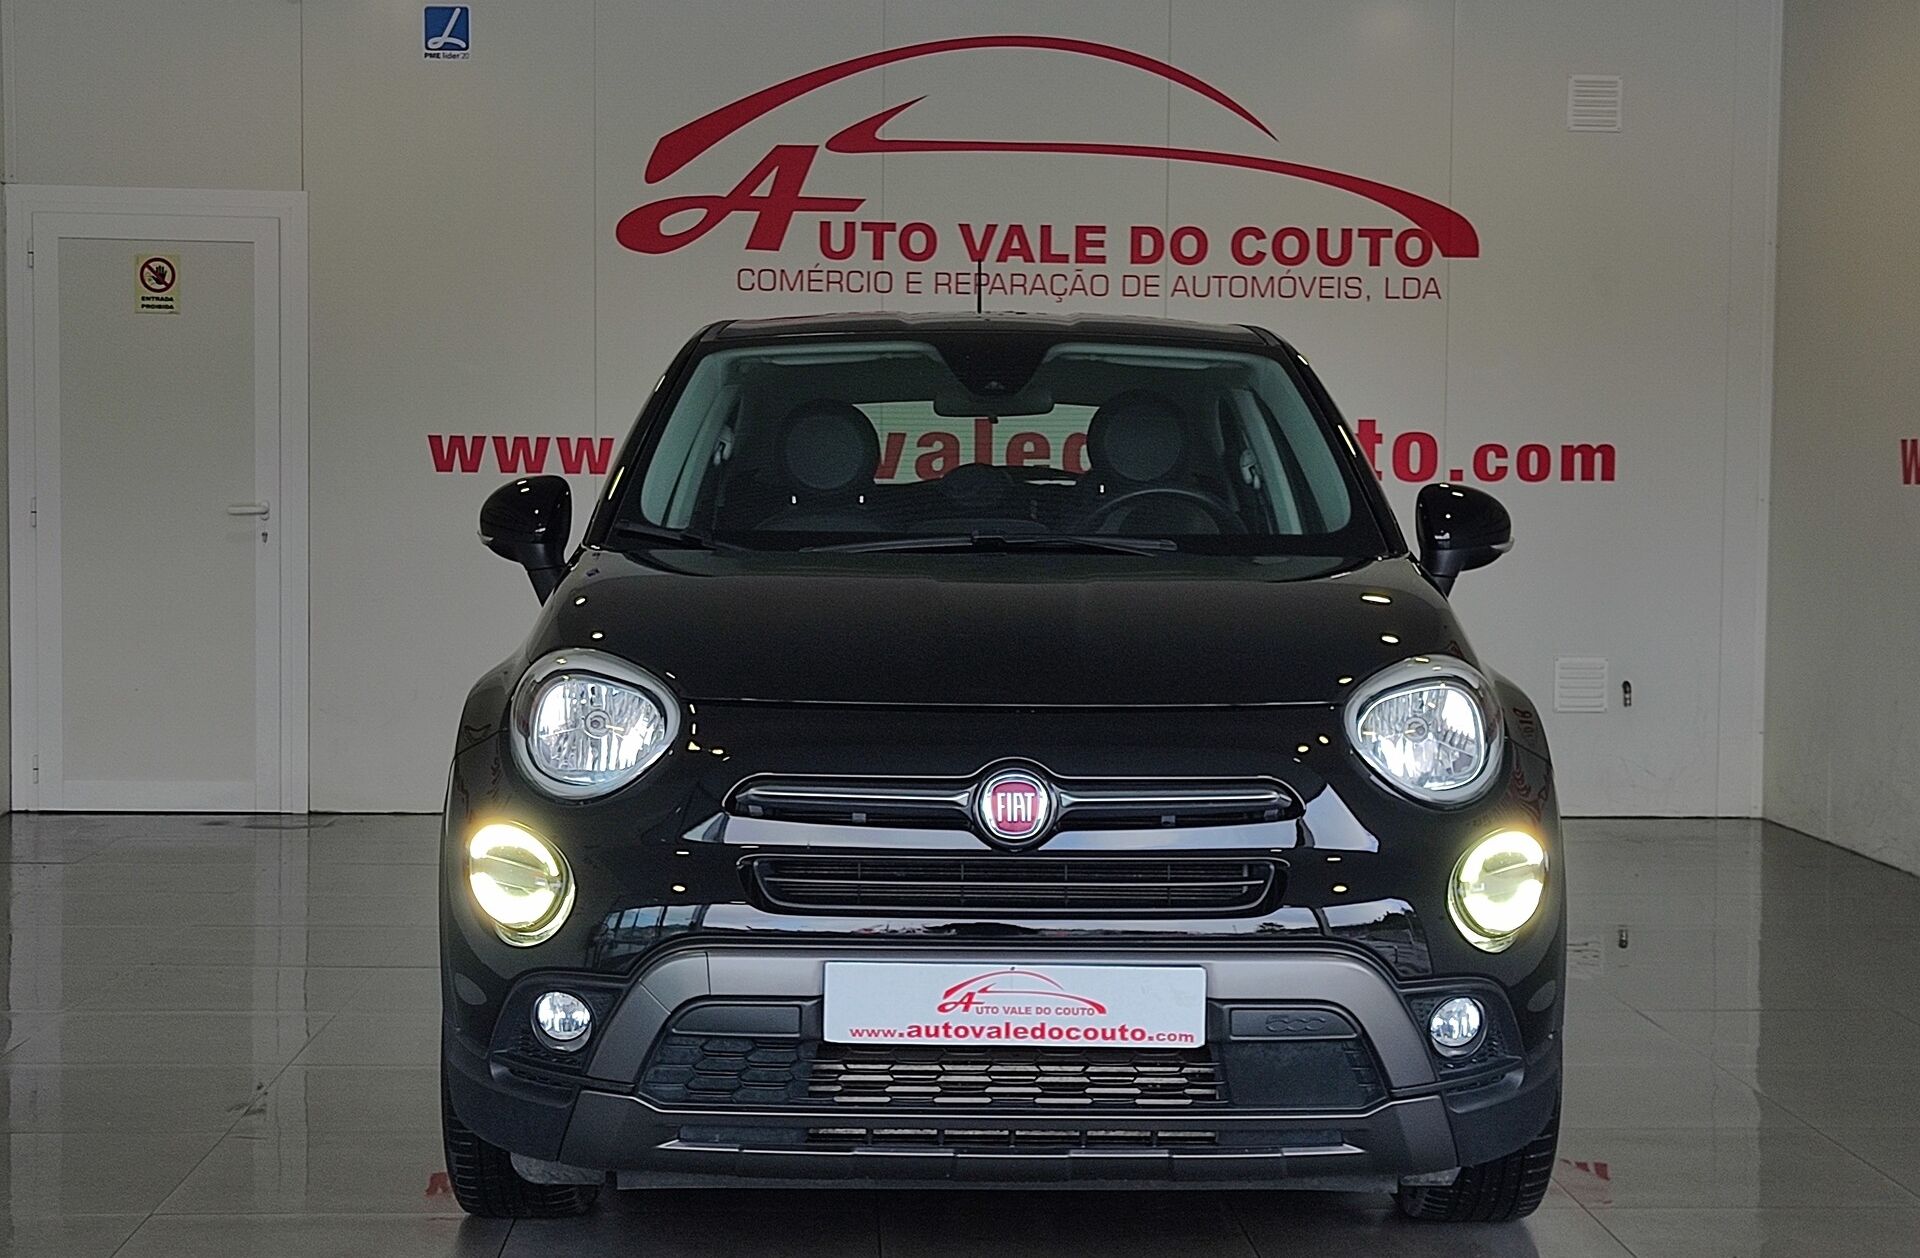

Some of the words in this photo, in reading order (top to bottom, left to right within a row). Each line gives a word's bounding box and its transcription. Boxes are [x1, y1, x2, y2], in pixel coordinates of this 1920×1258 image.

[958, 223, 1107, 264] VALE
[1130, 226, 1209, 265] DO
[1230, 227, 1434, 267] COUTO
[736, 263, 893, 293] COMÉRCIO
[905, 271, 922, 294] E
[934, 269, 1110, 303] REPARAÇÃO
[1121, 274, 1160, 298] DE
[1171, 270, 1371, 302] AUTOMÓVEIS,
[1384, 276, 1442, 300] LDA
[997, 792, 1036, 822] FIAT
[1003, 1006, 1032, 1015] VALE
[1035, 1007, 1050, 1015] DO
[1055, 1007, 1095, 1016] COUTO
[849, 1022, 1196, 1043] www.autovaledocouto.com
